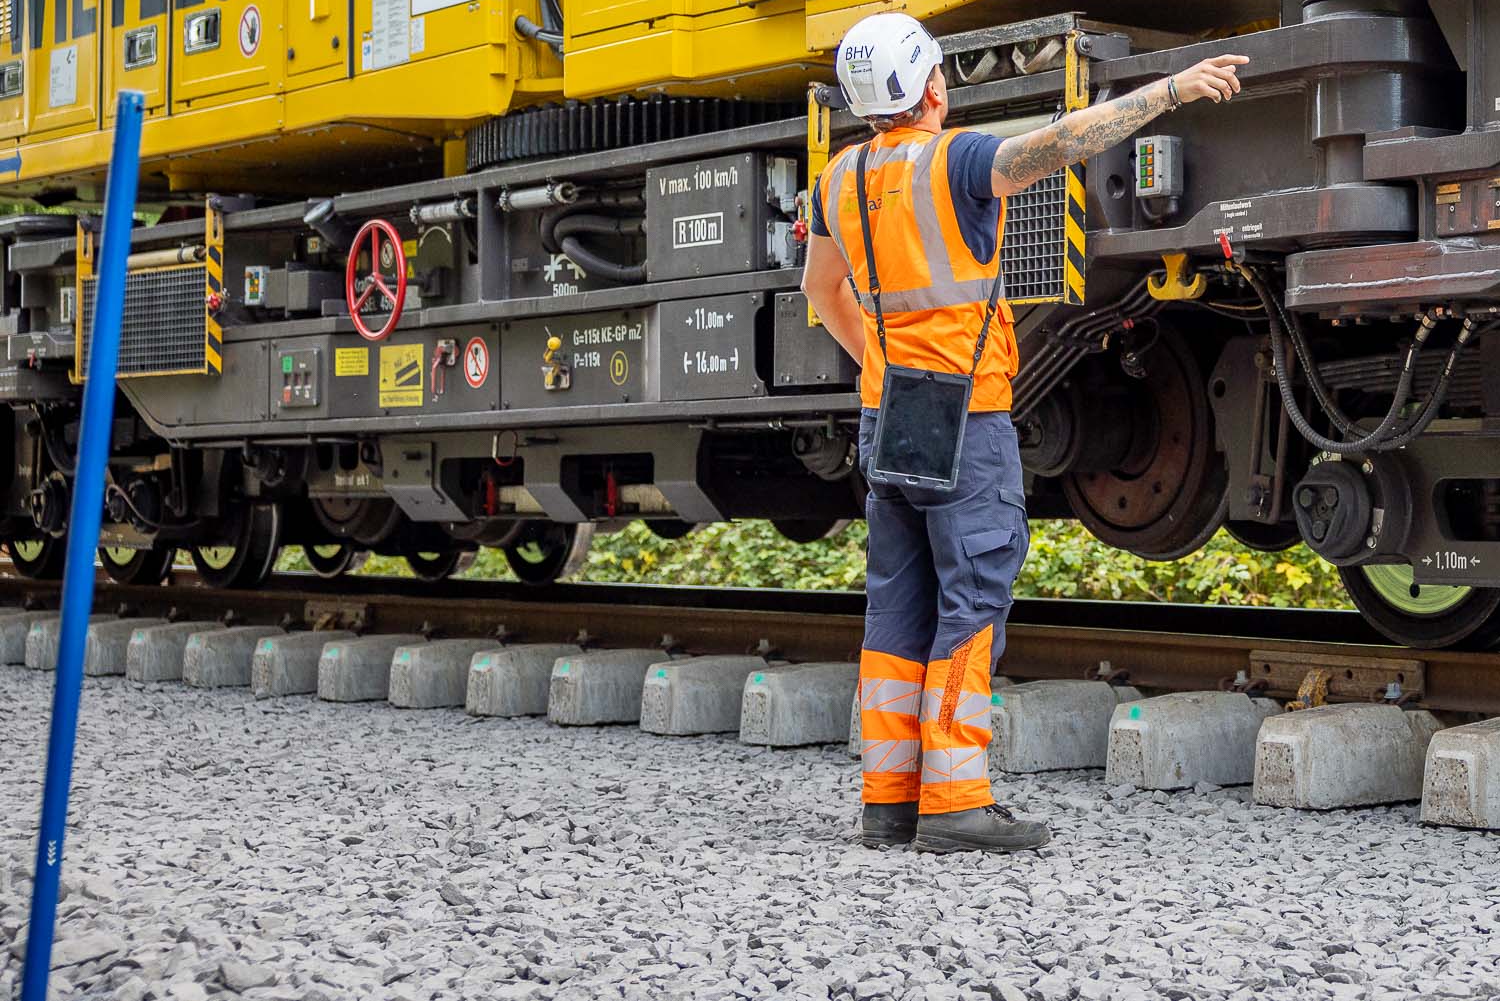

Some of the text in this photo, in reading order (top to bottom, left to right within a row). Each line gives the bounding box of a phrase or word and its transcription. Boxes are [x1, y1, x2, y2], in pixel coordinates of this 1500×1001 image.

[845, 45, 875, 61] BHV
[659, 166, 738, 197] V max. 100 km/h
[678, 221, 687, 244] R
[552, 283, 578, 297] 500m
[601, 324, 627, 344] KE-GP
[628, 323, 642, 341] mZ
[574, 352, 600, 369] P=115t
[615, 359, 624, 377] D
[1435, 551, 1467, 570] 1,10m
